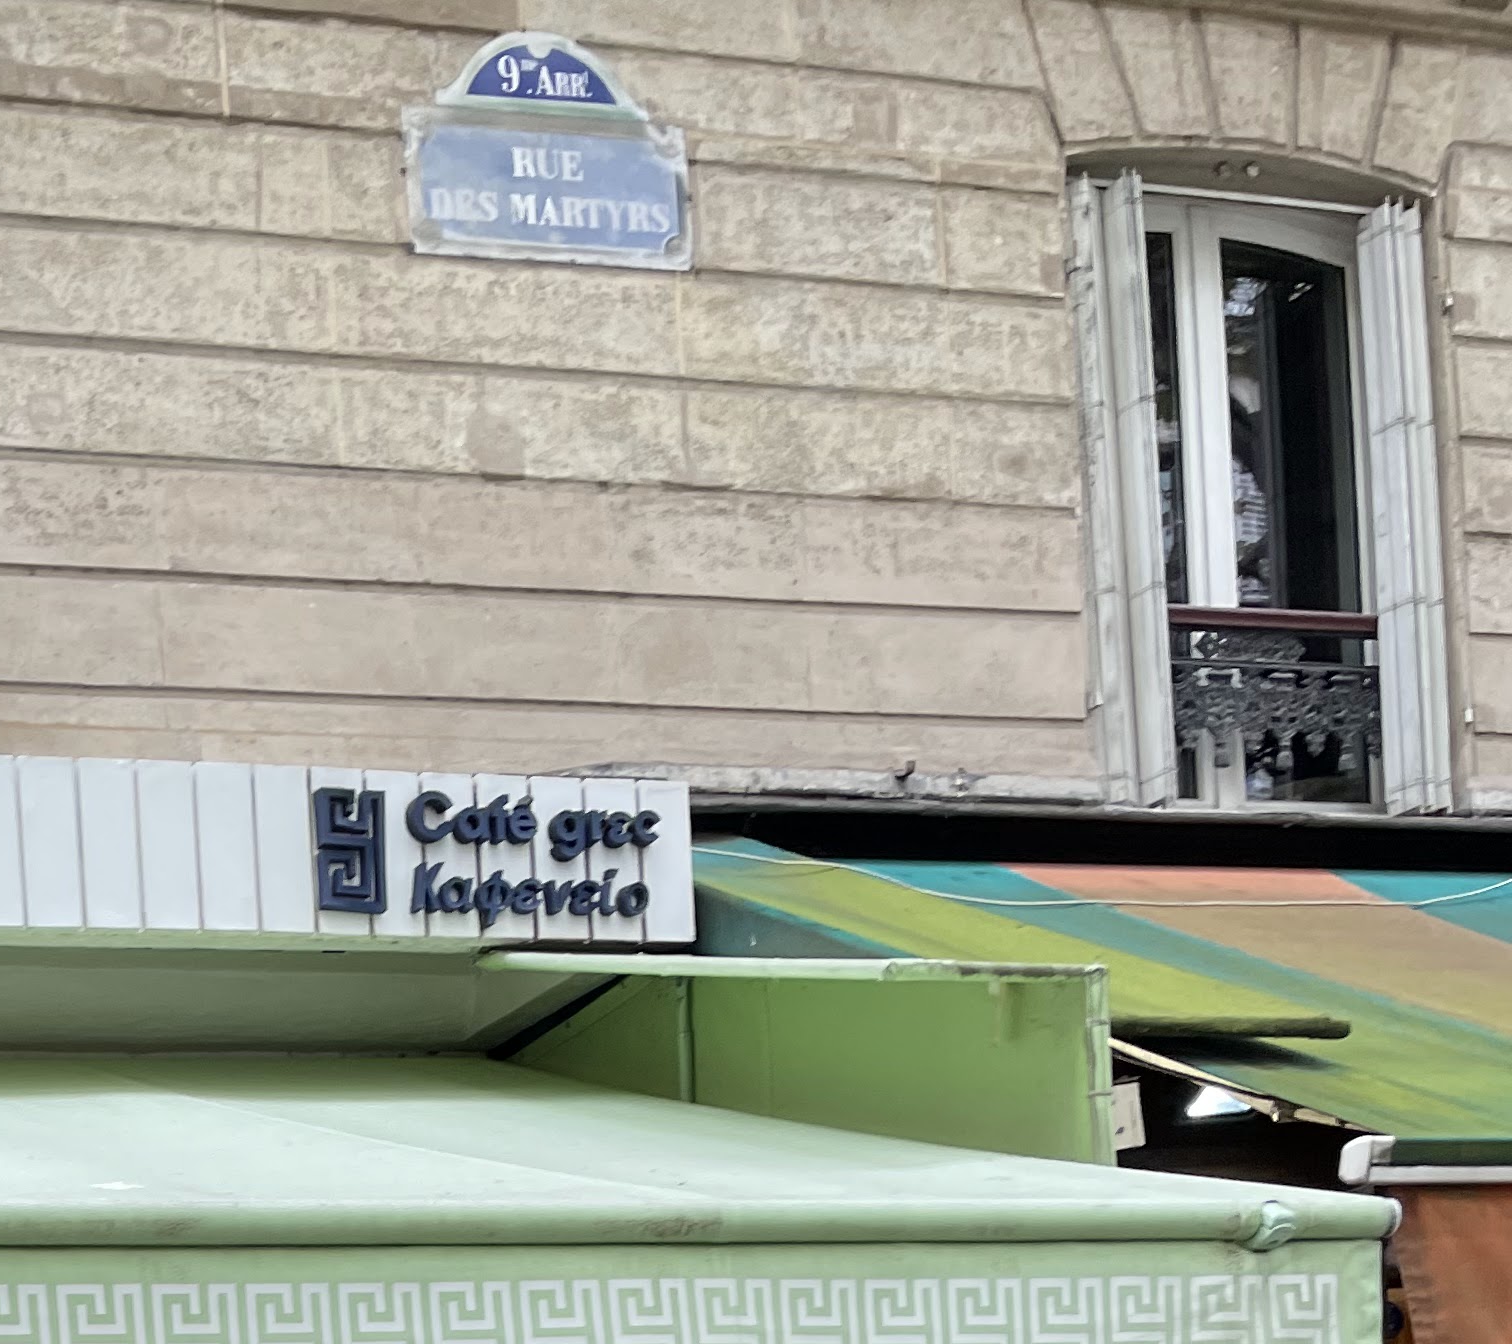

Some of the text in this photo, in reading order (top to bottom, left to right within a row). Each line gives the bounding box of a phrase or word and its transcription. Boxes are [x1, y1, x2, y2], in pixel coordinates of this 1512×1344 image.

[512, 146, 584, 182] RUE
[429, 187, 671, 234] DES MARTYRS
[406, 791, 660, 862] Café grec
